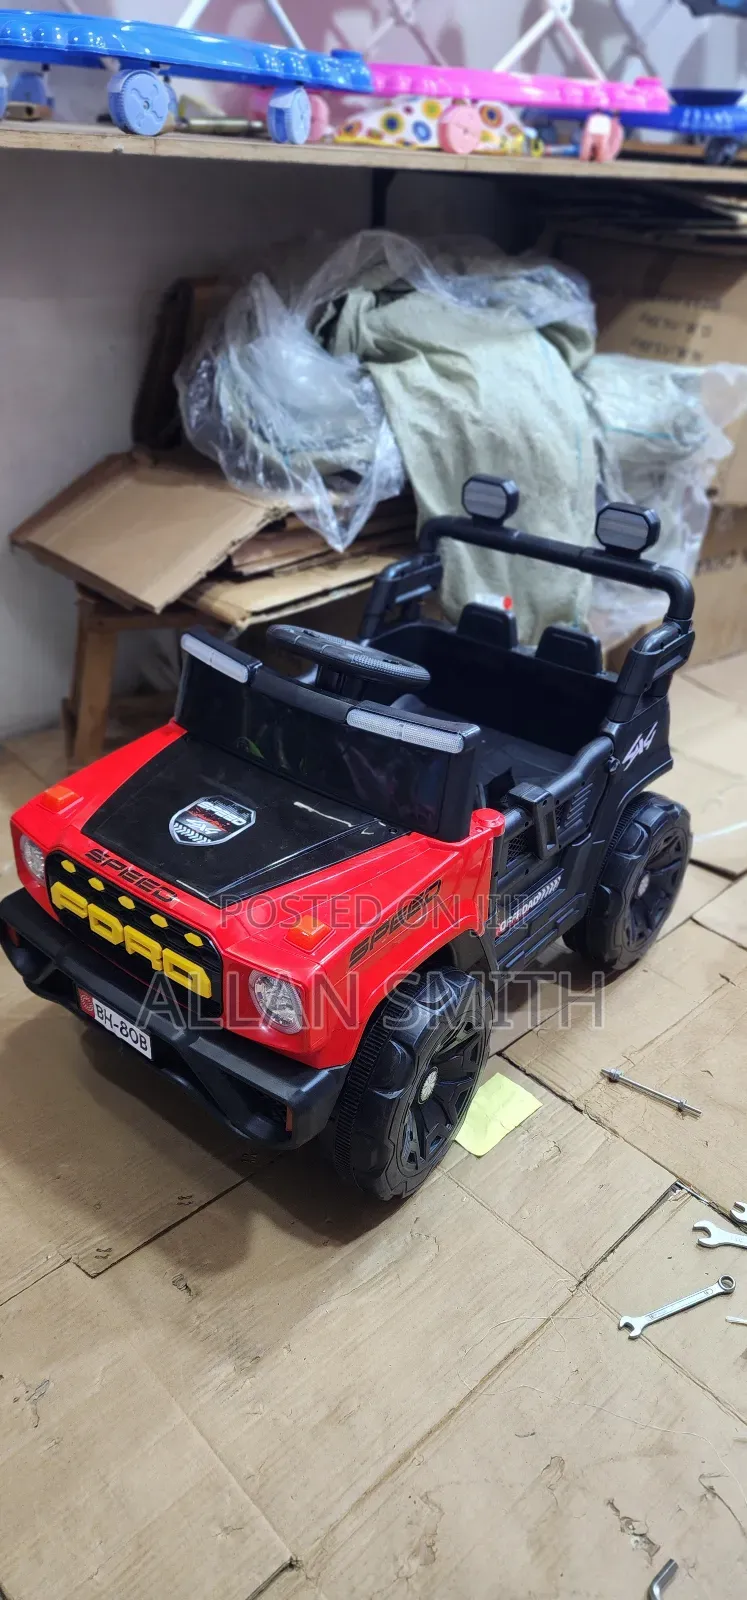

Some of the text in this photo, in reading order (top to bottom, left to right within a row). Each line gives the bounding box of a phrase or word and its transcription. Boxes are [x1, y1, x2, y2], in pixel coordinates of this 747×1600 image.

[197, 801, 247, 826] SPEED
[85, 848, 178, 902] SPEED
[349, 879, 442, 968] SPEED
